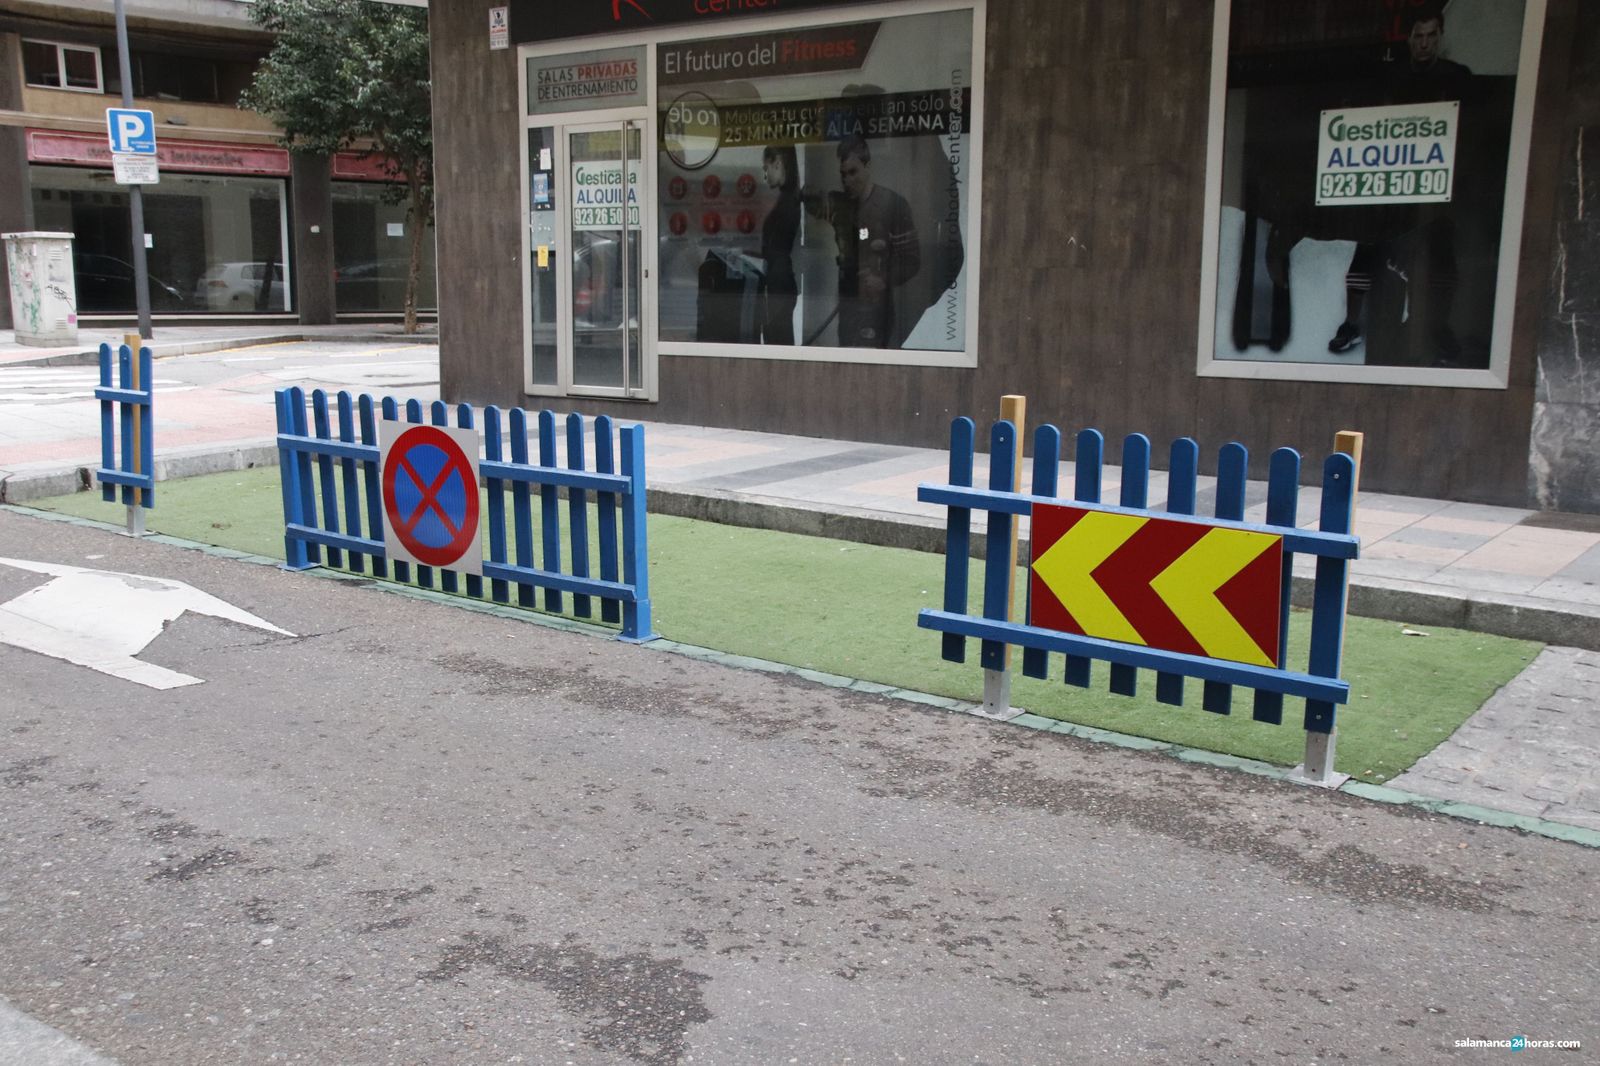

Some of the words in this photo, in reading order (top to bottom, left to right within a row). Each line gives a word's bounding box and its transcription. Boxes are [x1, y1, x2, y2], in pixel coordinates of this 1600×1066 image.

[665, 51, 680, 74] El
[686, 50, 743, 72] futuro
[748, 41, 776, 66] del
[781, 38, 856, 64] Fitness
[537, 68, 574, 84] SALAS
[577, 62, 637, 79] PRIVADAS
[537, 86, 551, 100] DE
[553, 79, 638, 99] ENTRENAMIENTO
[782, 106, 796, 122] tu
[800, 104, 854, 121] cue
[880, 96, 906, 114] tan
[911, 94, 944, 113] sólo
[118, 114, 145, 149] P
[725, 127, 742, 143] 25
[747, 122, 822, 142] MINUTOS
[827, 120, 839, 137] A
[842, 119, 864, 136] LA
[868, 113, 944, 134] SEMANA
[1327, 114, 1448, 142] Gesticasa
[1327, 142, 1444, 168] ALQUILA
[576, 167, 637, 186] Gesticaa
[1322, 173, 1357, 197] 923
[1361, 172, 1386, 196] 26
[1390, 171, 1415, 195] 50
[1420, 170, 1447, 194] 90
[575, 208, 594, 225] 923
[595, 207, 608, 224] 26
[610, 207, 623, 224] 50
